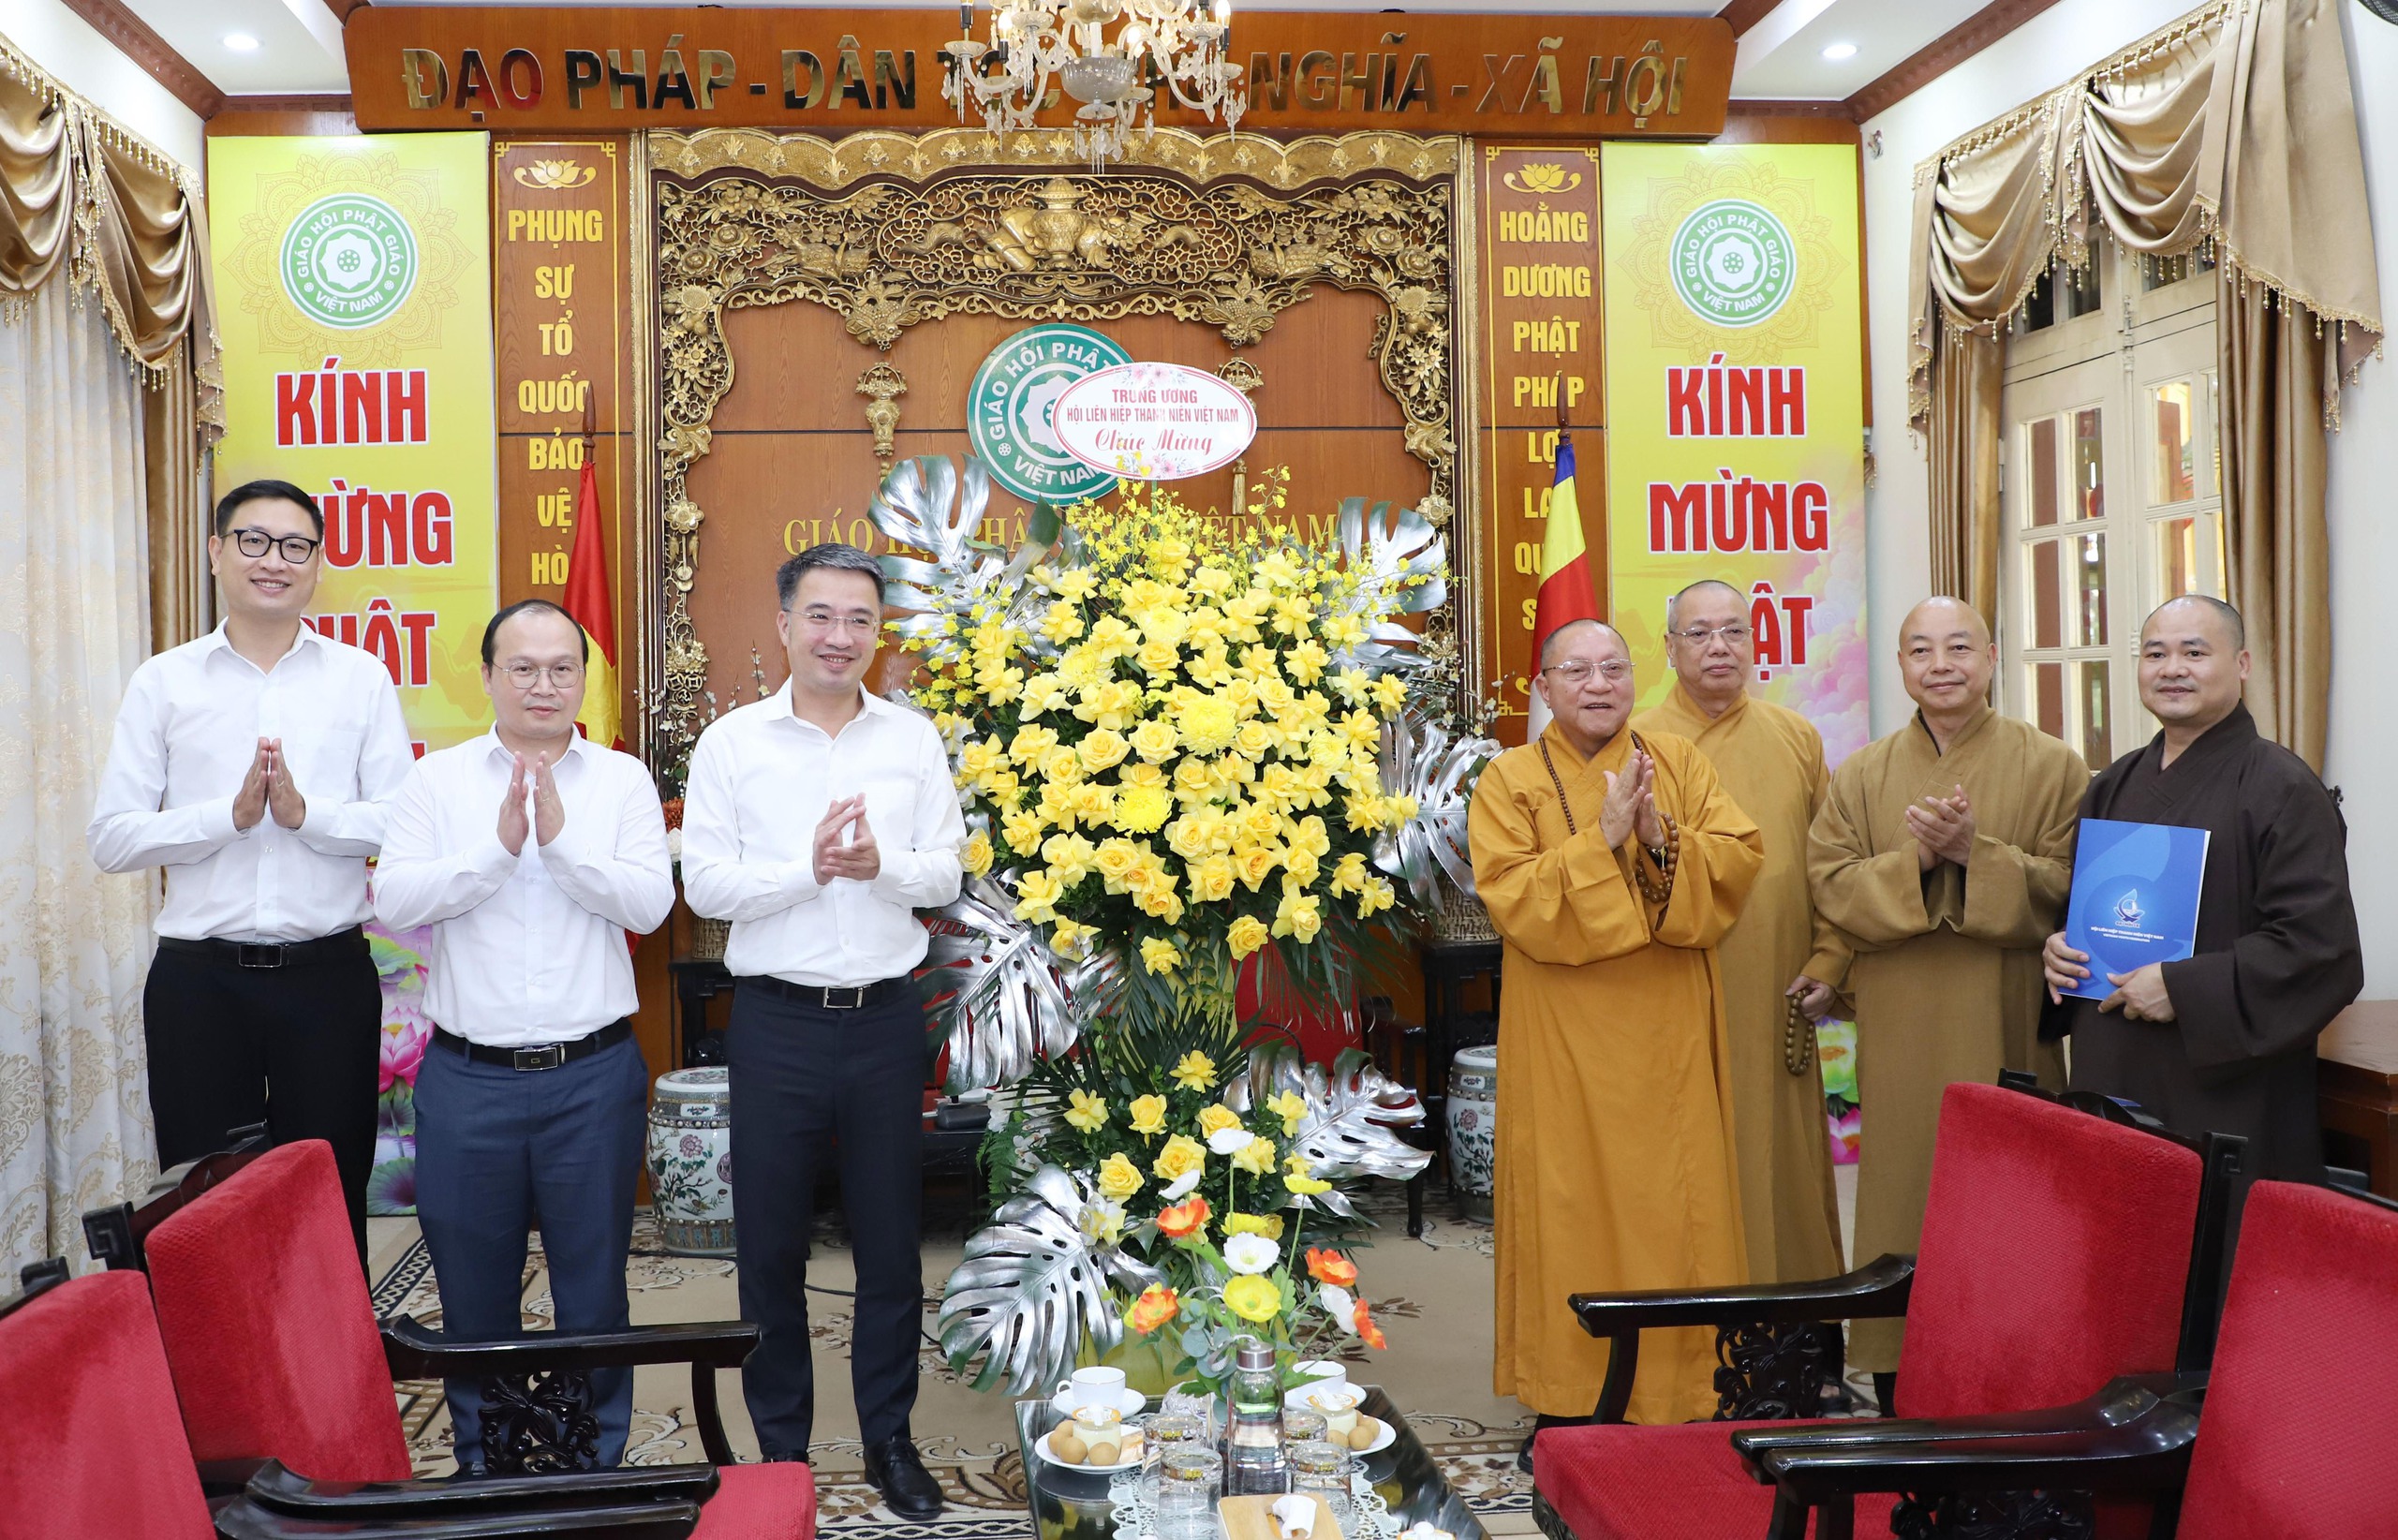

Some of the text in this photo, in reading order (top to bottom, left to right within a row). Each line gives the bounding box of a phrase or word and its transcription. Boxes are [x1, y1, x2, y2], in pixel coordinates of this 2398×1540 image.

[401, 48, 545, 122] ĐẠO
[565, 34, 736, 111] PHÁP
[781, 35, 916, 111] DÂN
[1248, 32, 1436, 112] NGHĨA
[1477, 36, 1563, 114] XÃ
[1583, 39, 1688, 130] HỘI
[509, 209, 604, 249] PHỤNG
[1500, 200, 1589, 243] HOẰNG
[294, 209, 404, 278] GIÁO HỘI PHẬT GIÁO
[1683, 214, 1784, 278] GIÁO HỘI PHẬT GIÁO
[316, 290, 384, 313] VIỆT NAM
[535, 263, 575, 305] SỰ
[1502, 263, 1591, 298] DƯƠNG
[1703, 290, 1766, 312] VIỆT NAM
[539, 309, 573, 356] TỔ
[1513, 316, 1580, 359] PHẬT
[276, 356, 428, 447] KÍNH
[984, 380, 1009, 441] GIÁO
[1004, 345, 1044, 379] HỘI
[1067, 404, 1239, 425] HỘI LIÊN HIỆP THANH NIÊN VIỆT NAM
[1112, 388, 1198, 404] TRUNG ƯƠNG
[1667, 353, 1806, 437] KÍNH
[528, 426, 585, 470] BẢO
[1095, 427, 1213, 456] Chúc Mừng
[1528, 428, 1562, 469] LỢ
[1014, 455, 1057, 486] VIỆT
[310, 479, 452, 568] ỪNG
[537, 487, 572, 534] VỆ
[783, 508, 874, 555] GIÁO
[1649, 468, 1828, 553] MỪNG
[531, 544, 570, 585] HÒ
